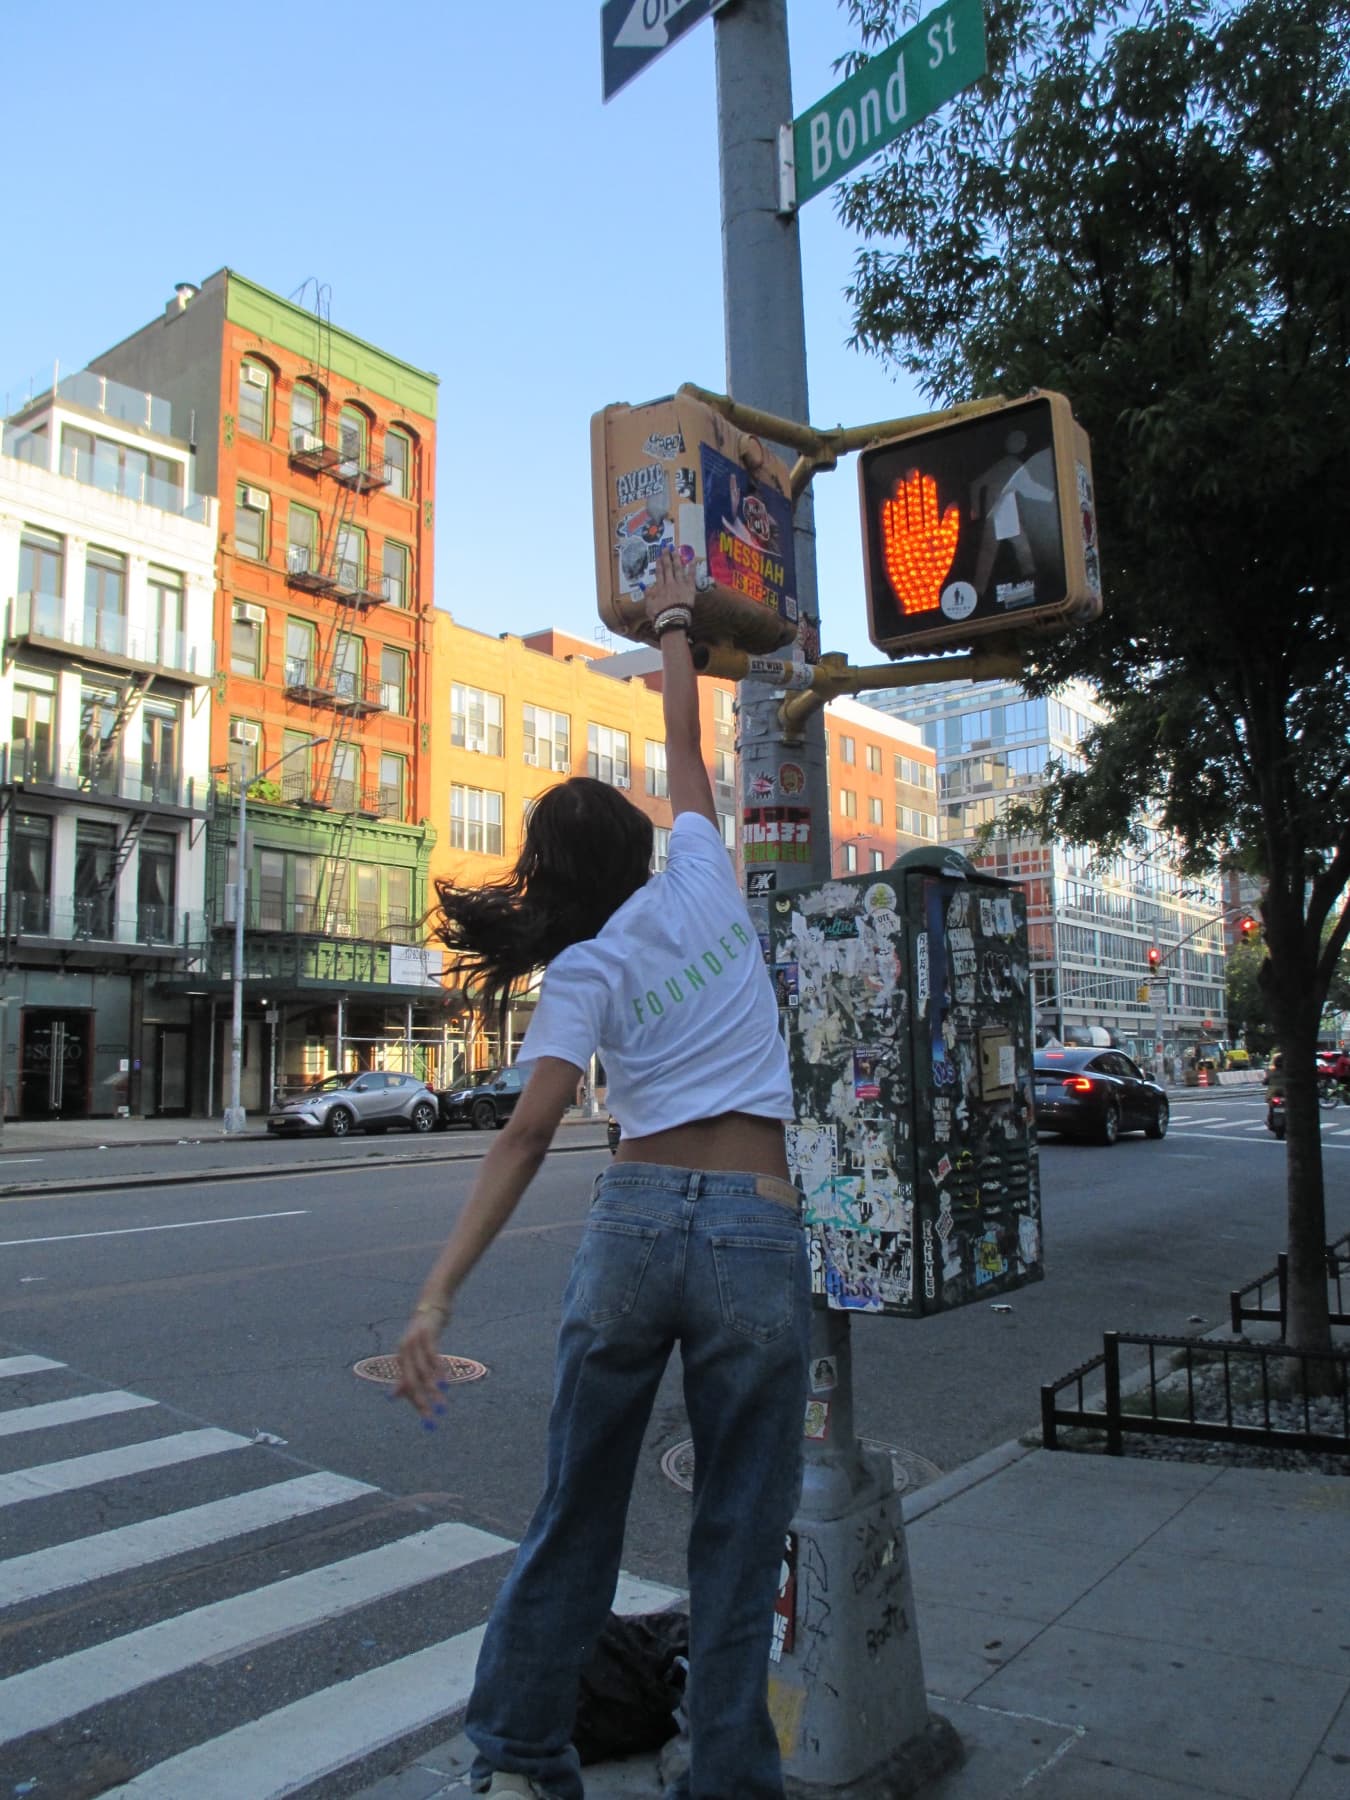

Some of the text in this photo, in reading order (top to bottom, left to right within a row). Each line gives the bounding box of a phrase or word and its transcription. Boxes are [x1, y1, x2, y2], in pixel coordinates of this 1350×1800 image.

[810, 14, 957, 182] Bond St
[617, 463, 664, 496] AVOID
[719, 531, 785, 588] MESSIAH
[732, 570, 779, 611] IS HERE!
[632, 922, 750, 1025] FOUNDER
